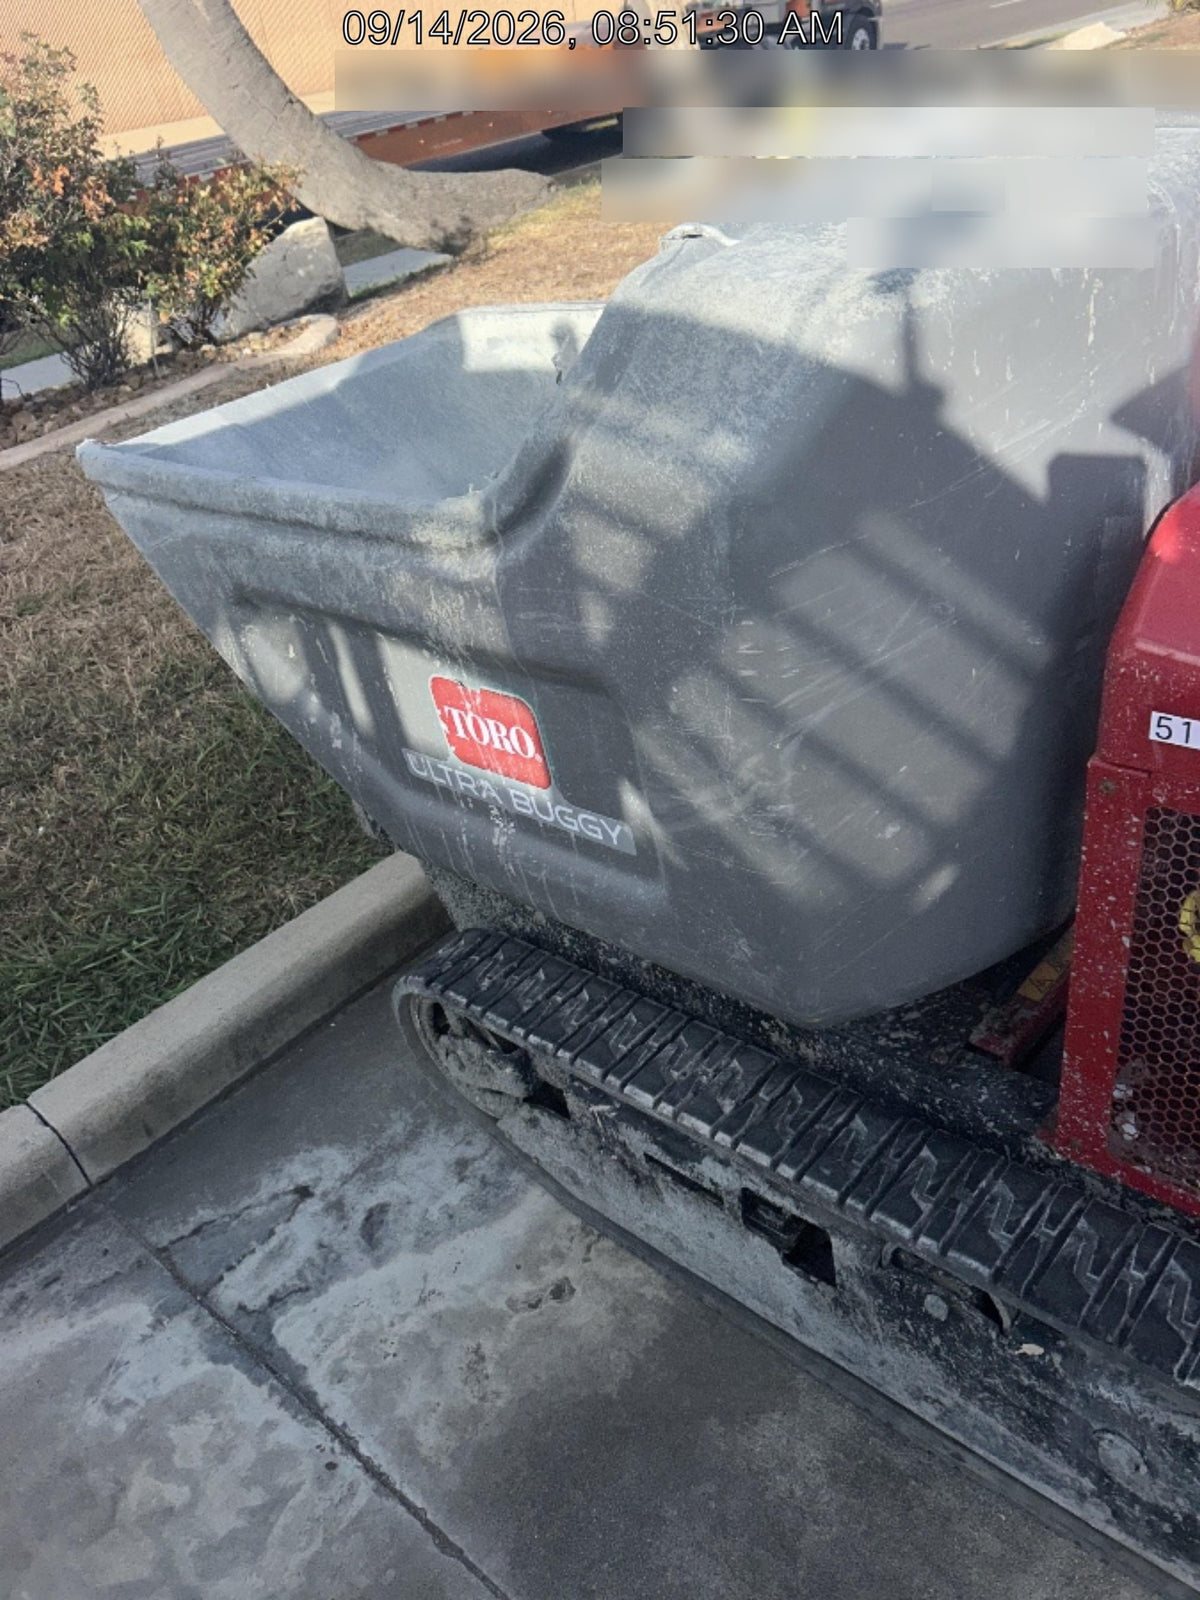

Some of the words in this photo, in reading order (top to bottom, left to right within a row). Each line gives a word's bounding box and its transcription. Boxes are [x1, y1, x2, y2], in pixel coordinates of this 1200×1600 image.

[443, 705, 536, 759] TORO
[406, 751, 503, 804] ULTRA
[509, 788, 624, 845] BUGGY
